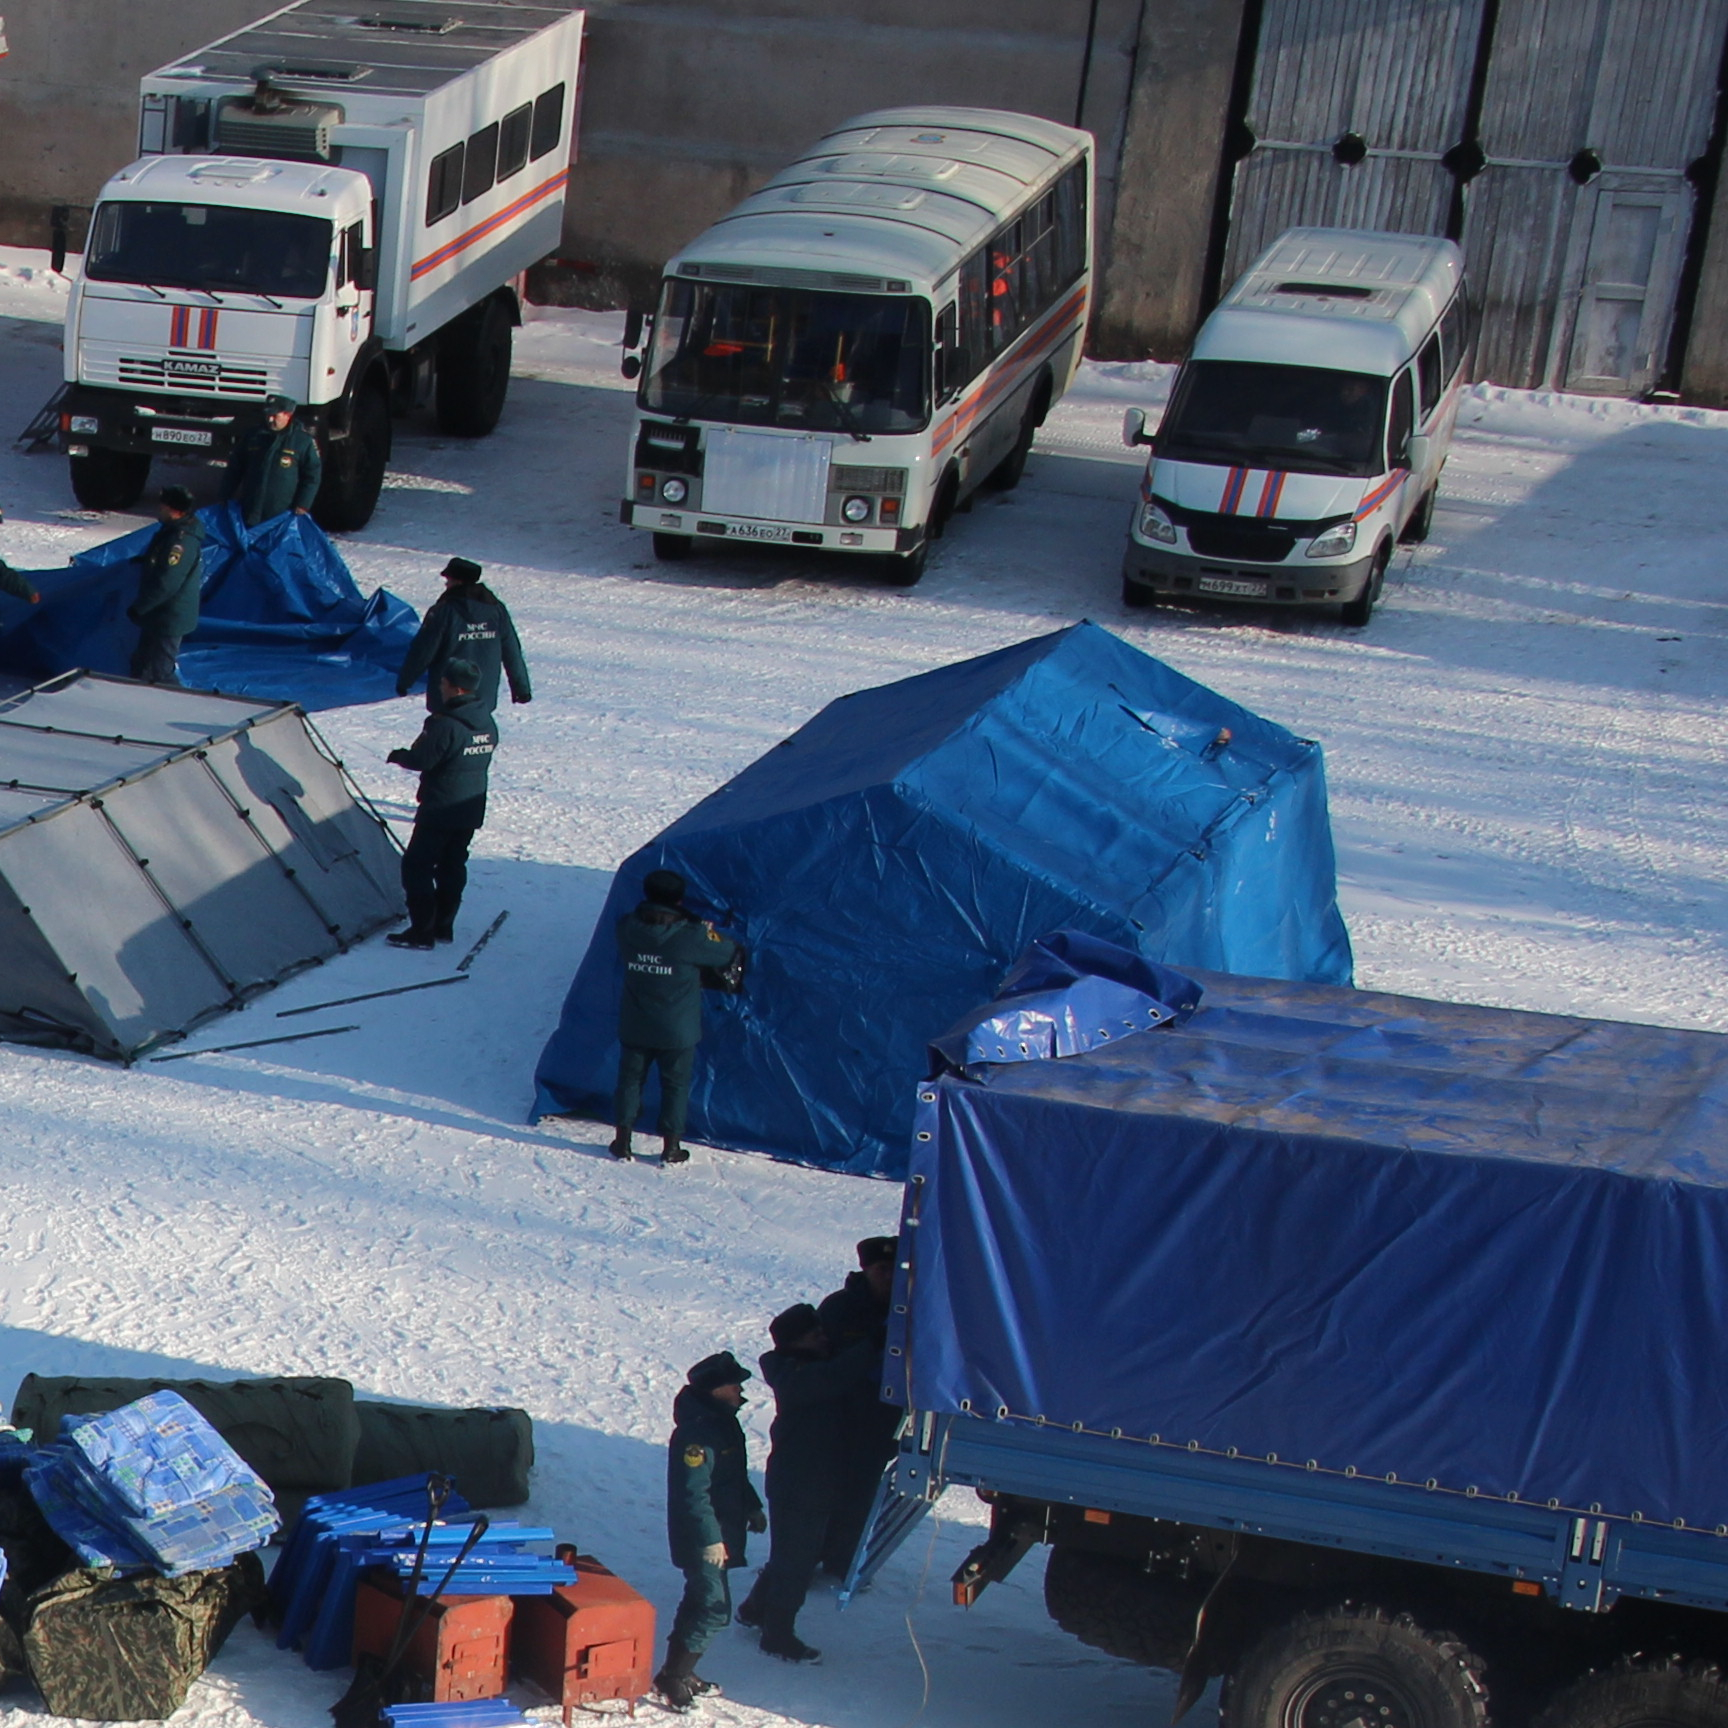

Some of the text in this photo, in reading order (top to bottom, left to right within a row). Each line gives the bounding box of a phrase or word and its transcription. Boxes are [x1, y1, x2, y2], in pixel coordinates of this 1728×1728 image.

[164, 361, 219, 374] KAMAZ
[637, 953, 663, 964] МЧС
[628, 962, 672, 975] РОССИИ
